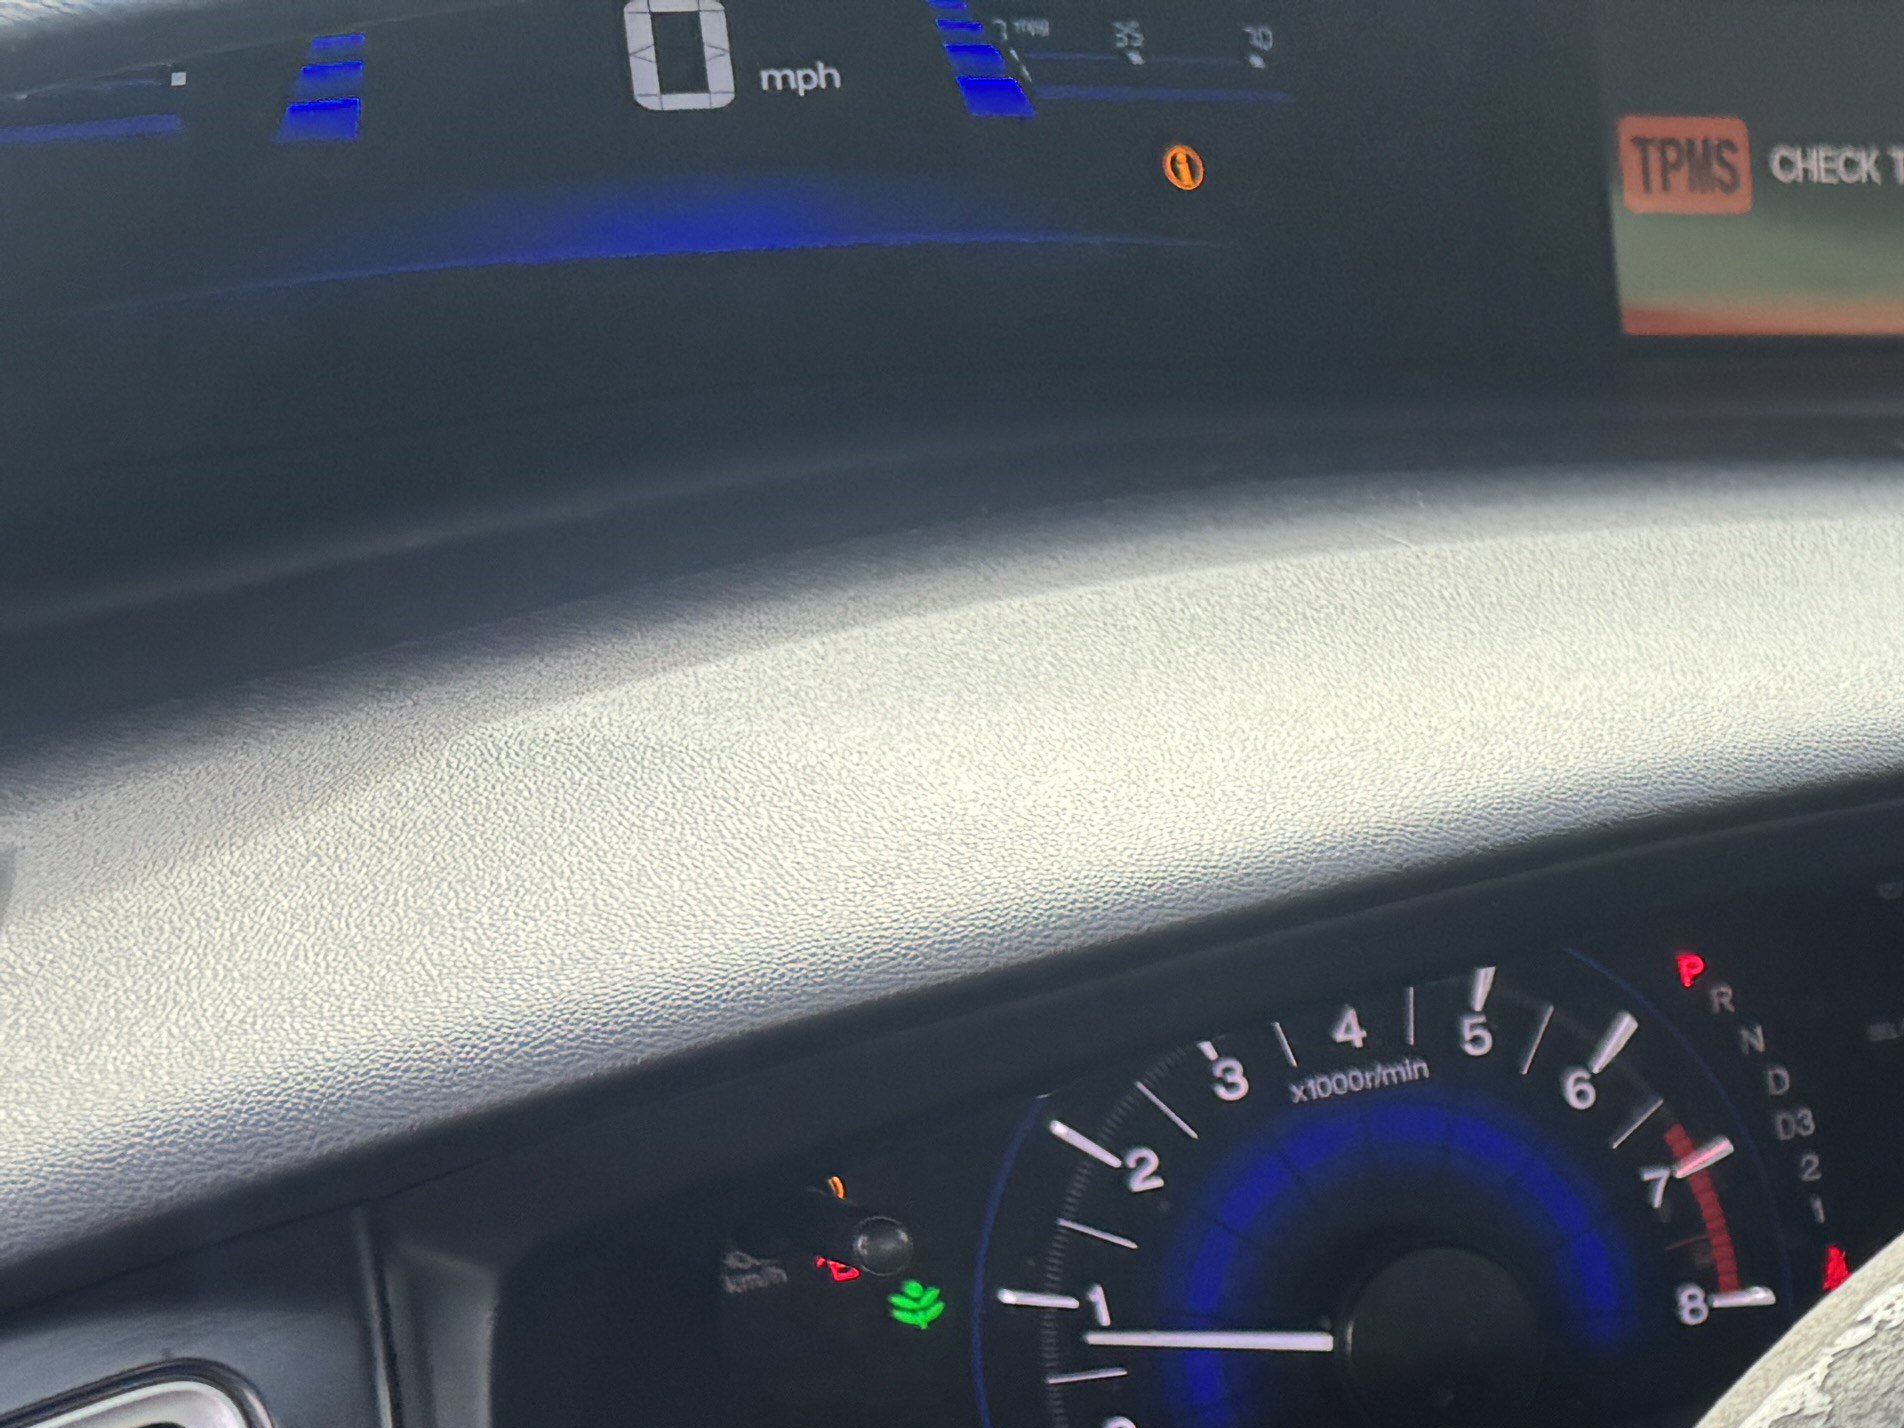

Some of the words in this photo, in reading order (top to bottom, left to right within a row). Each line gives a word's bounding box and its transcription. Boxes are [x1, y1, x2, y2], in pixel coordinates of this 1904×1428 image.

[623, 0, 735, 110] 0
[760, 61, 841, 96] mph
[1632, 135, 1741, 196] TPMS
[1769, 144, 1882, 187] CHECK
[1676, 952, 1706, 988] P
[1710, 982, 1735, 1013] R
[1331, 1004, 1367, 1049] 4
[1459, 1012, 1493, 1056] 5
[1740, 1023, 1765, 1055] N
[1212, 1057, 1250, 1101] 3
[1289, 1057, 1430, 1104] x1000r/min
[1562, 1066, 1596, 1110] 6
[1767, 1065, 1790, 1095] D
[1775, 1106, 1816, 1140] D3
[1125, 1147, 1165, 1193] 2
[1639, 1166, 1671, 1208] 7
[1800, 1152, 1822, 1182] 2
[1810, 1194, 1825, 1224] 1
[1086, 1283, 1111, 1327] 1
[1676, 1283, 1709, 1325] 8
